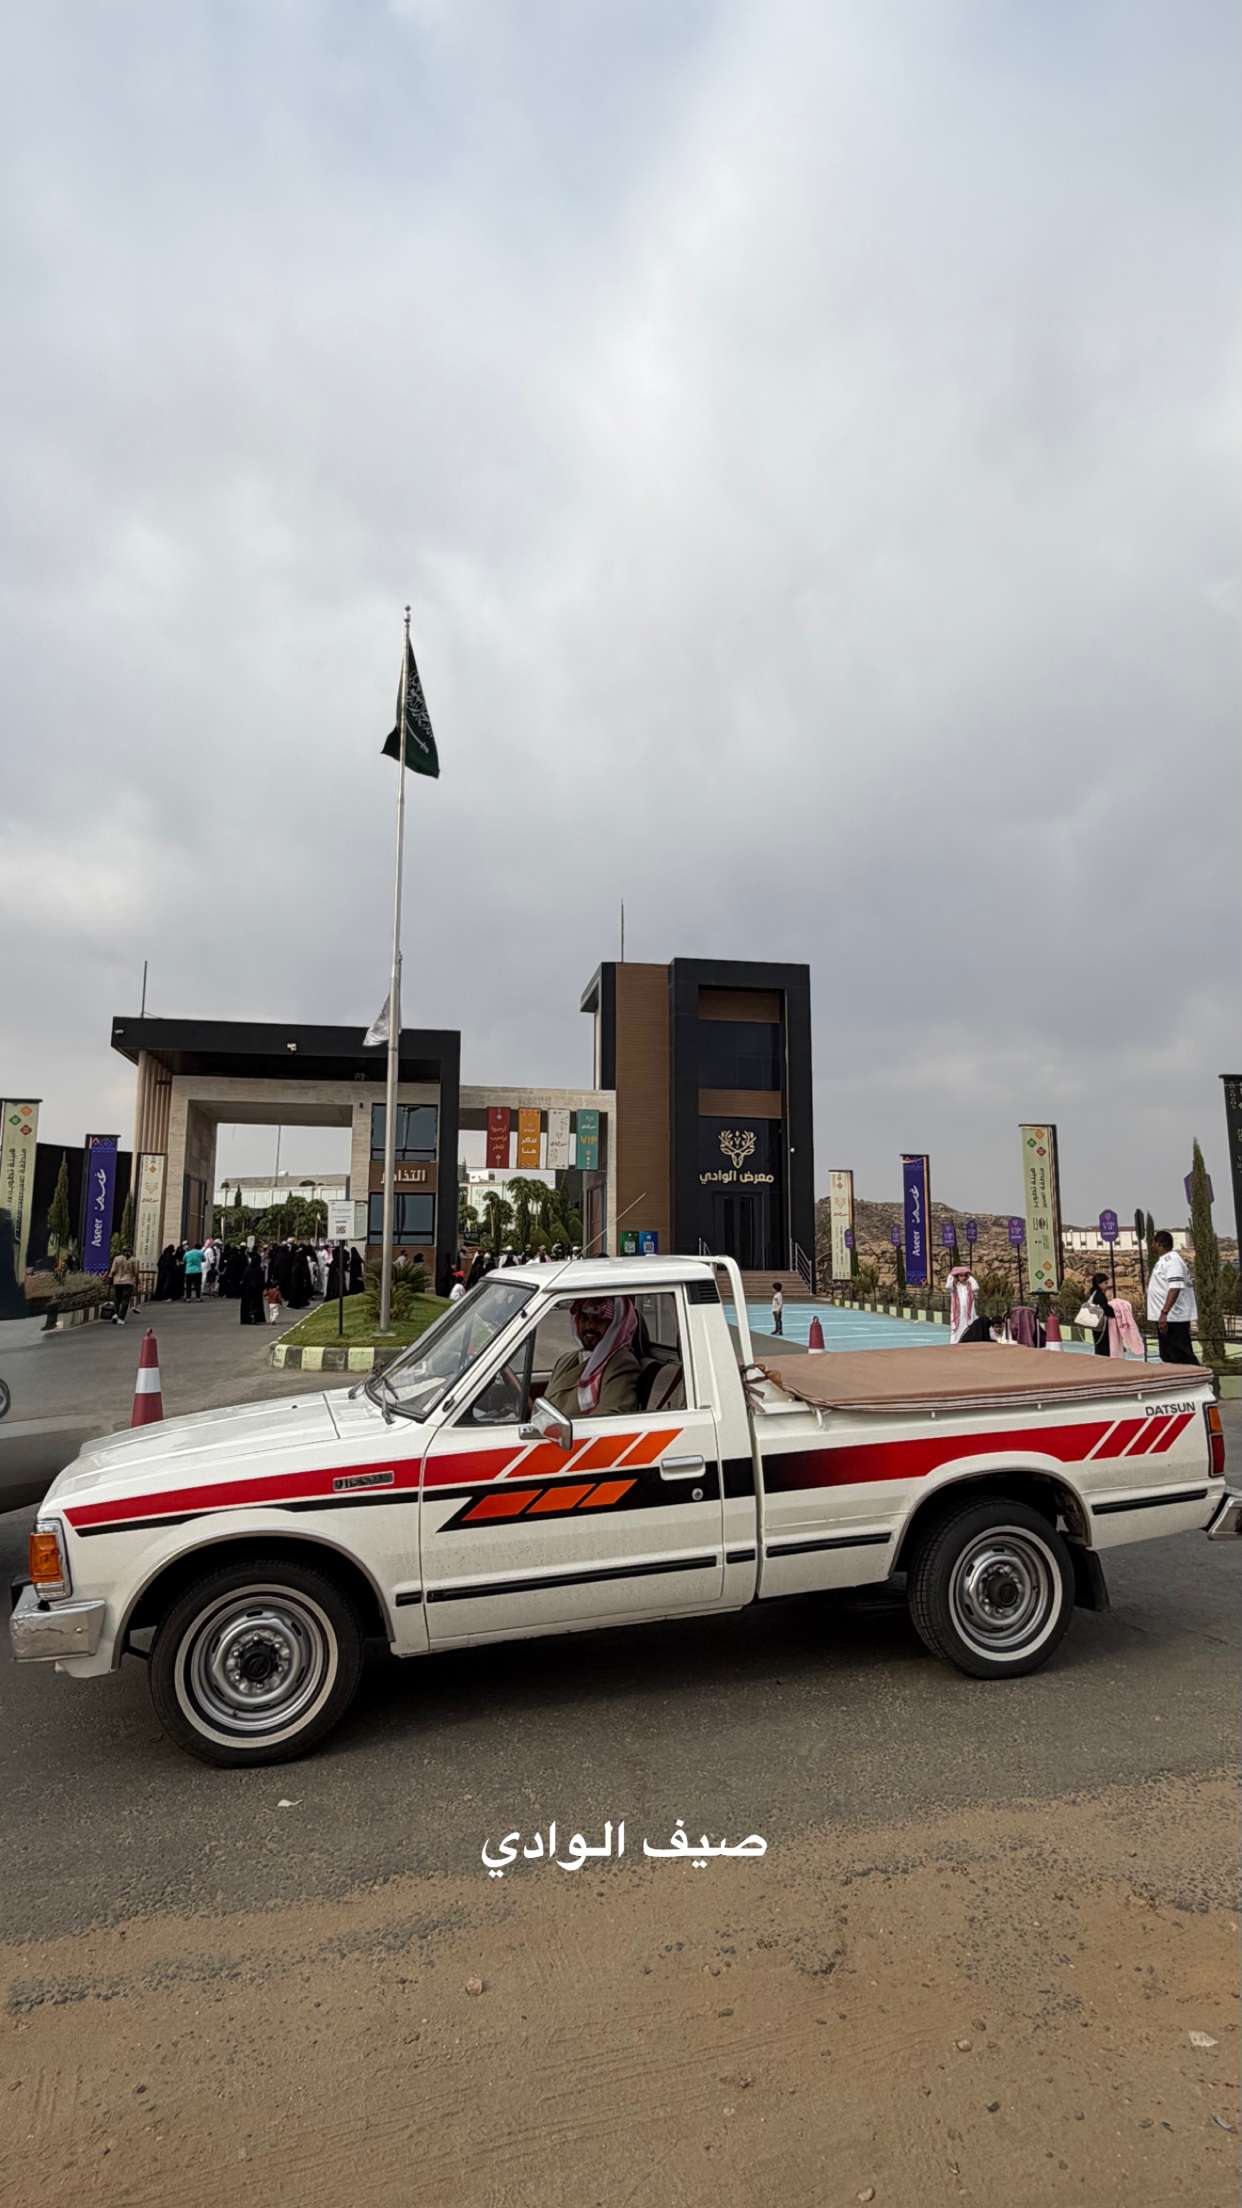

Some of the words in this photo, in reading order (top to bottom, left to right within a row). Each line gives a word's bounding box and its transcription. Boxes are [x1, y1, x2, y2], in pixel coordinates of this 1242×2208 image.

[380, 1169, 426, 1185] التذار
[699, 1169, 737, 1185] الوادي
[739, 1171, 775, 1185] معرض
[91, 1218, 103, 1247] Aseer
[912, 1231, 921, 1257] Aseer
[1145, 1401, 1196, 1417] DATSUN
